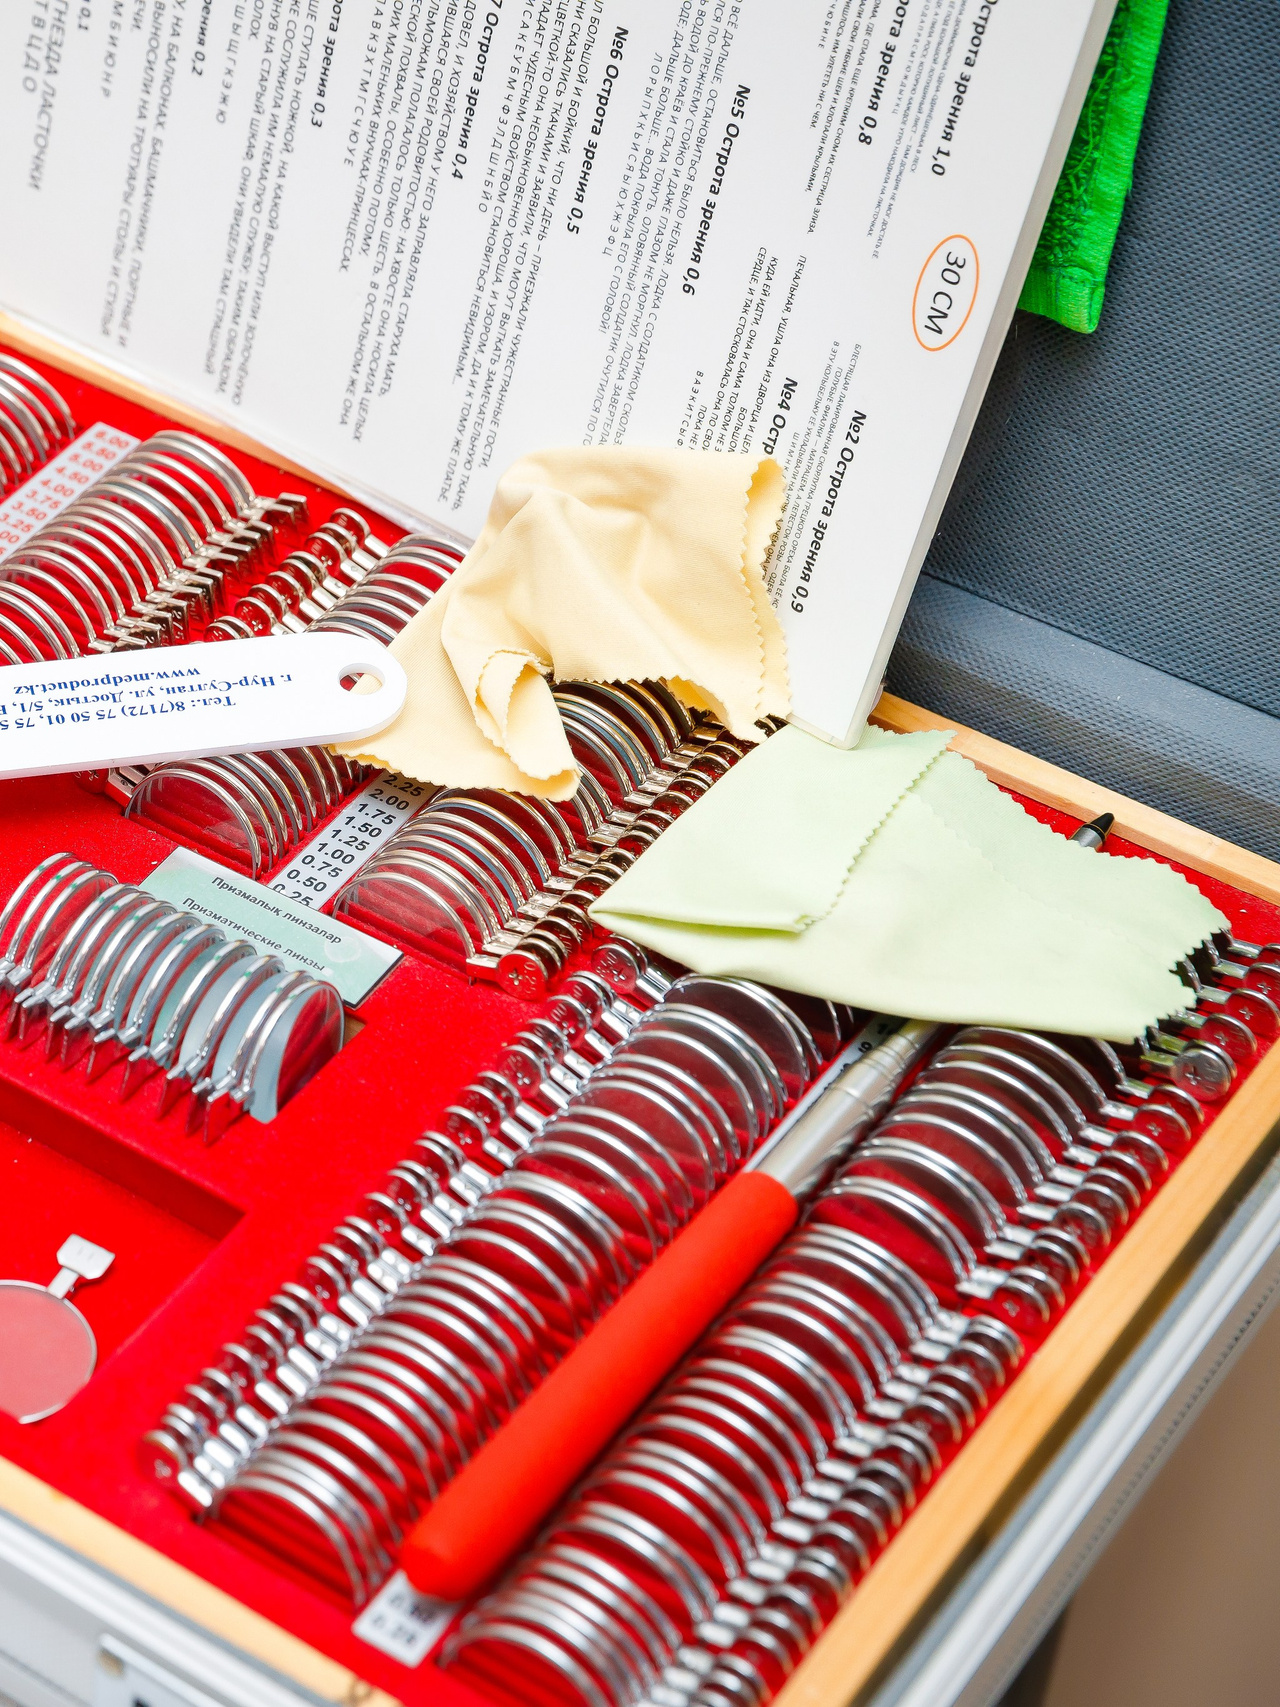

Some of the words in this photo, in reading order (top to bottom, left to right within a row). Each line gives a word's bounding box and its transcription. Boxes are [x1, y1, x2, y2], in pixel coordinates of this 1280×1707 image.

[76, 5, 92, 31] 0,1
[725, 4, 741, 29] ВСЁ
[471, 11, 499, 83] Острота
[574, 14, 600, 85] БОЛЬШОЙ
[609, 25, 629, 61] №6
[709, 27, 734, 85] ДАЛЬШЕ,
[190, 49, 206, 76] 0,2
[315, 35, 336, 98] зрения
[452, 53, 465, 66] И
[571, 85, 583, 98] И
[866, 41, 896, 112] зрения
[310, 101, 326, 128] 0,3
[431, 66, 462, 163] ХОЗЯЙСТВОМ
[589, 63, 619, 136] Острота
[730, 83, 751, 120] №5
[940, 70, 972, 142] зрения
[457, 85, 480, 150] зрения
[555, 98, 580, 156] БОЙКИЙ,
[857, 114, 877, 146] 0,8
[685, 87, 719, 182] ОСТАНОВИТЬСЯ
[429, 163, 441, 176] У
[450, 152, 467, 180] 0,4
[550, 159, 566, 185] ЧТО
[573, 138, 598, 204] зрения
[708, 122, 740, 196] Острота
[930, 145, 951, 176] 1,0
[421, 175, 438, 211] НЕГО
[544, 185, 559, 207] НИ
[675, 182, 693, 219] БЫЛО
[536, 204, 553, 242] ДЕНЬ
[566, 206, 584, 235] 0,5
[689, 197, 716, 264] зрения
[401, 211, 430, 298] ЗАПРАВЛЯЛА
[661, 219, 683, 266] НЕЛЬЗЯ.
[681, 266, 700, 296] 0,6
[763, 255, 779, 281] КУДА
[940, 250, 966, 286] 30
[514, 252, 542, 331] ПРИЕЗЖАЛИ
[650, 267, 669, 309] ЛОДКА
[759, 281, 771, 298] ЕЙ
[749, 296, 767, 326] ИДТИ,
[923, 290, 953, 335] СМ
[388, 301, 409, 356] СТАРУХА
[743, 328, 757, 350] ОНА
[625, 320, 655, 401] СОЛДАТИКОМ
[740, 350, 751, 361] И
[377, 358, 396, 397] МАТЬ,
[489, 332, 522, 428] ЧУЖЕСТРАННЫЕ
[732, 360, 748, 389] САМА
[776, 376, 798, 411] №4
[612, 401, 632, 446] СКОЛЬЗ
[719, 390, 740, 432] ТОЛКОМ
[715, 431, 727, 446] НЕ
[761, 413, 786, 455] Остр
[844, 409, 867, 445] №2
[477, 428, 497, 468] ГОСТИ,
[41, 479, 74, 497] 4.00
[820, 446, 854, 517] Острота
[12, 502, 47, 521] 3.50
[26, 490, 62, 510] 3.75
[798, 518, 828, 583] зрения
[790, 584, 809, 613] 0,9
[12, 666, 201, 696] www.medproduct.kz
[128, 685, 156, 698] ул.
[158, 673, 276, 695] Нур-Султан,
[279, 673, 292, 682] г.
[11, 699, 44, 713] 5/1,
[46, 689, 124, 707] Достык,
[120, 699, 186, 717] 8(7172)
[189, 695, 236, 707] Тел.:
[13, 716, 35, 729] 75
[38, 713, 66, 726] 01,
[69, 710, 91, 723] 50
[94, 707, 117, 720] 75
[369, 789, 410, 810] 2.00
[383, 774, 424, 797] 2.25
[344, 816, 382, 838] 1.50
[359, 803, 396, 825] 1.75
[318, 842, 355, 865] 1.00
[331, 829, 370, 851] 1.25
[287, 869, 327, 892] 0.50
[301, 855, 342, 878] 0.75
[210, 875, 283, 916] Призмалық
[281, 911, 342, 944] линзалар
[181, 896, 282, 950] Призматические
[282, 947, 325, 971] линзы
